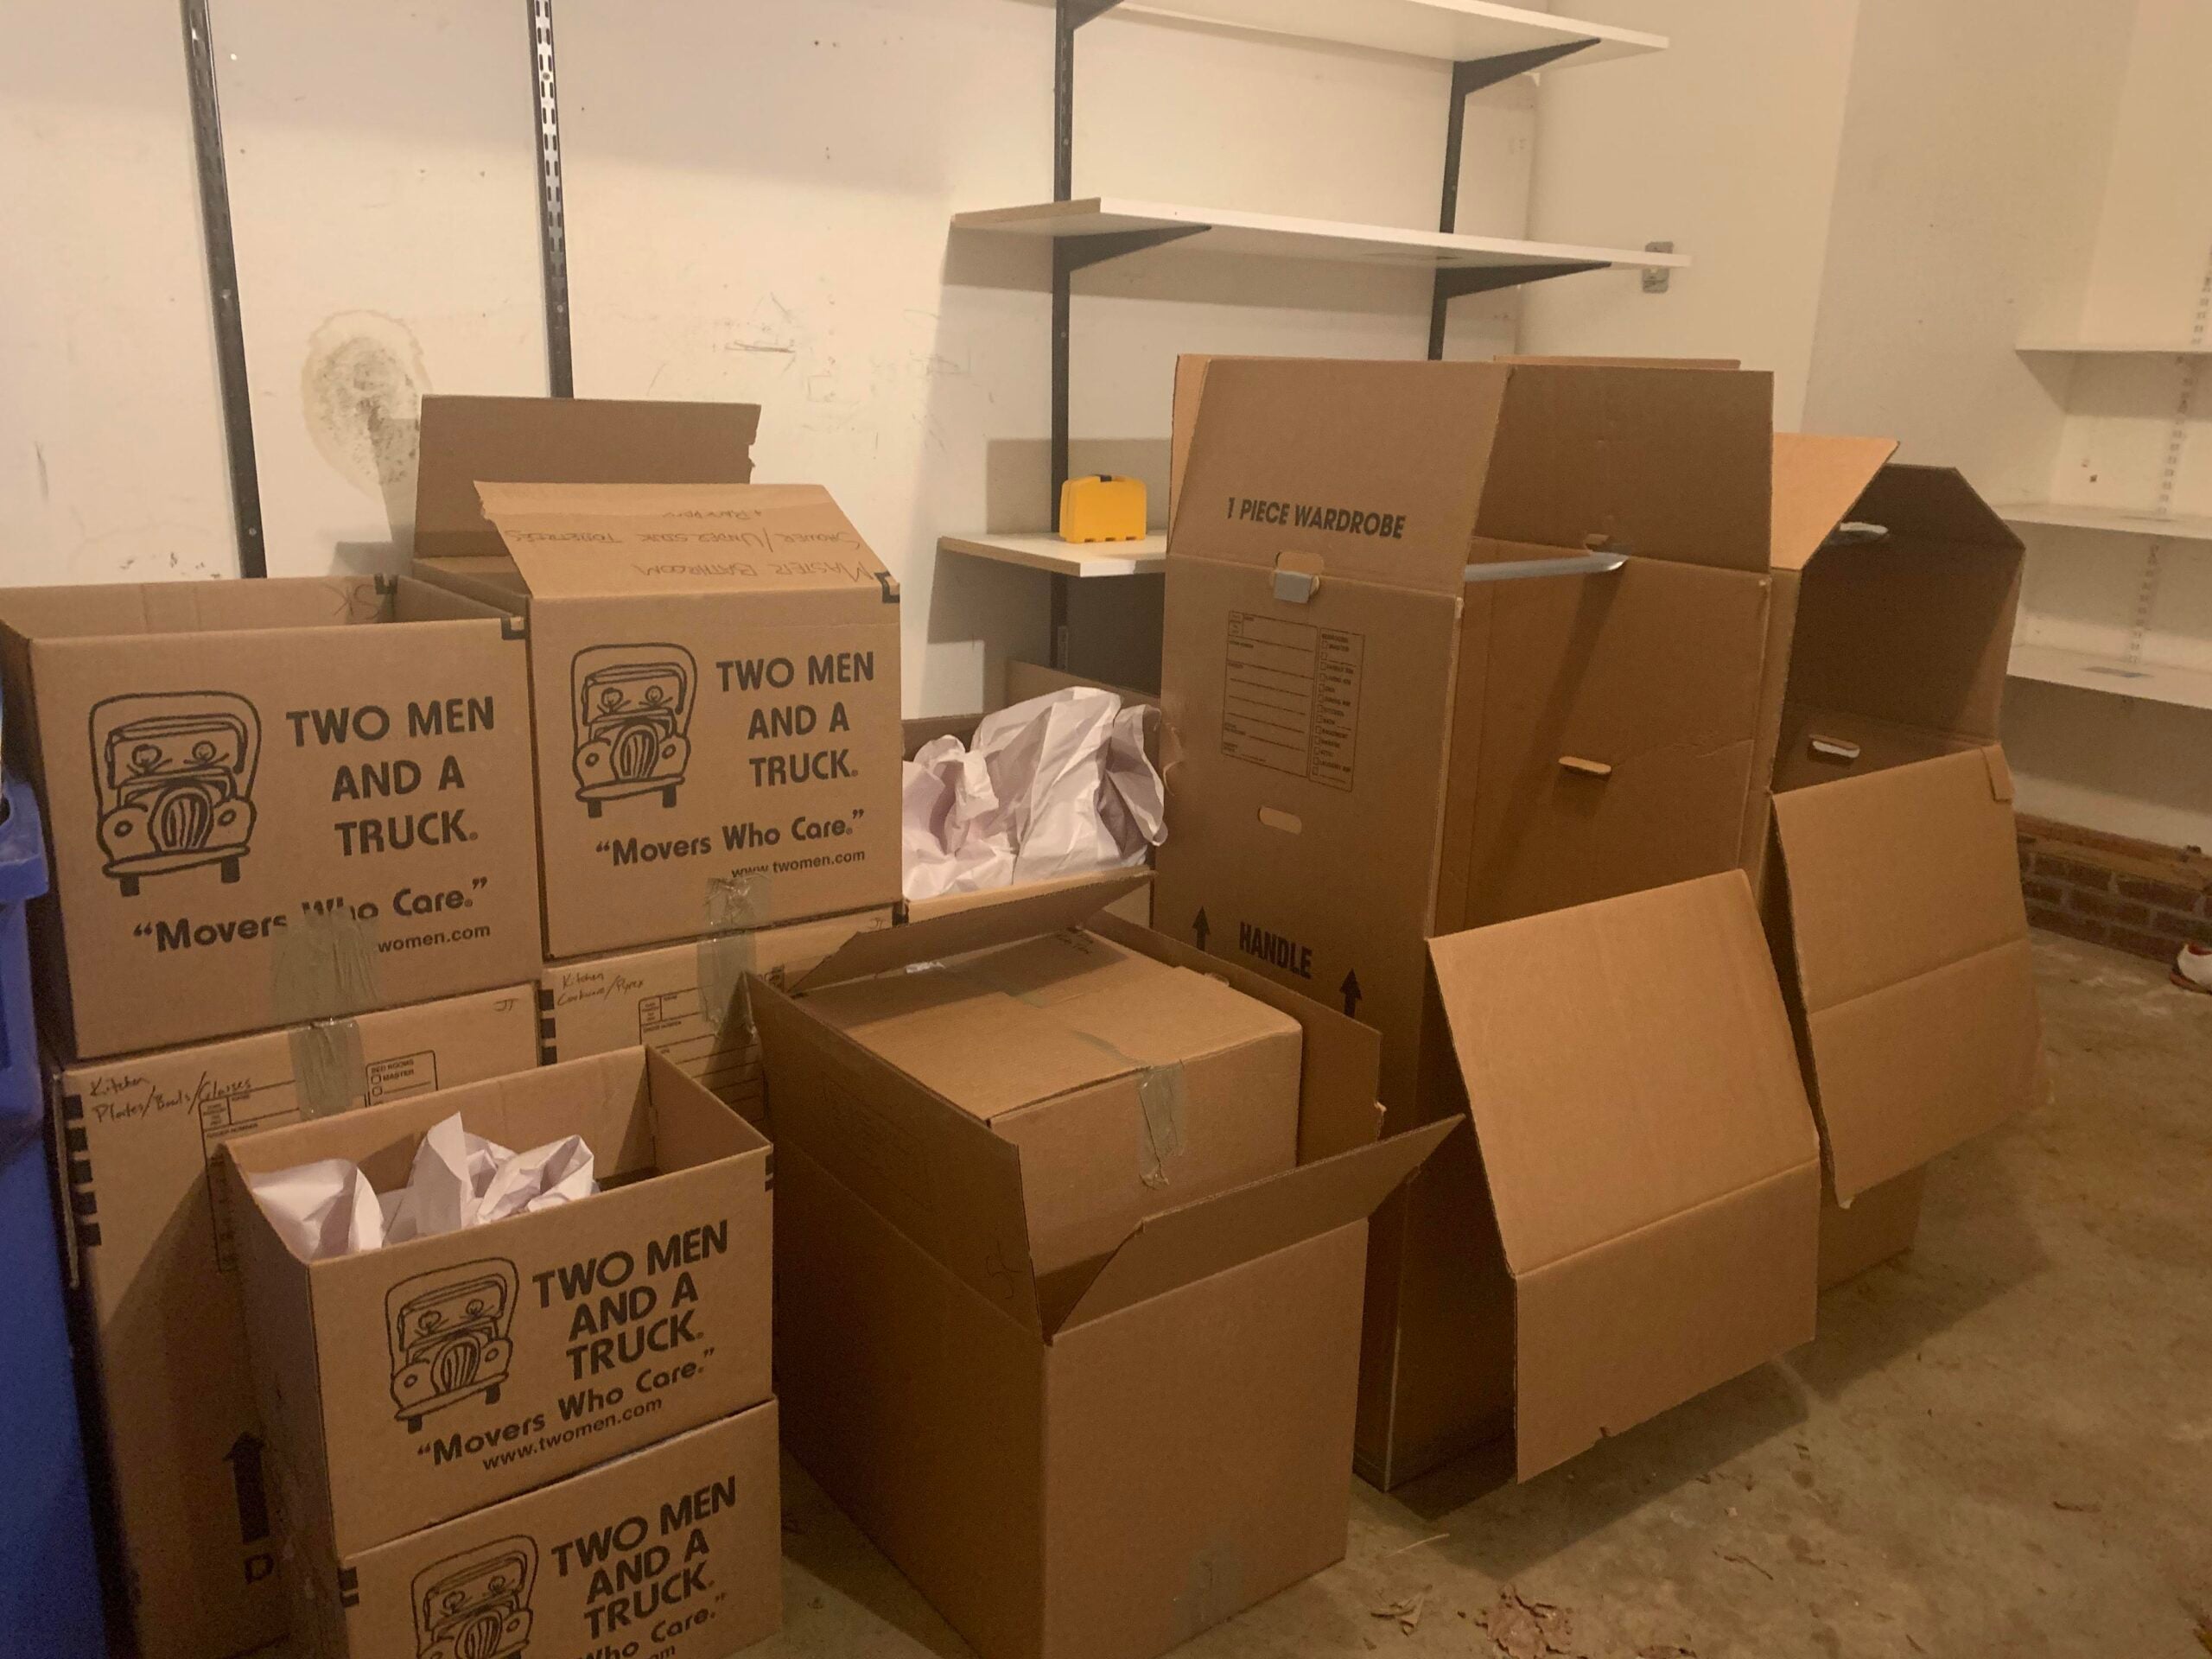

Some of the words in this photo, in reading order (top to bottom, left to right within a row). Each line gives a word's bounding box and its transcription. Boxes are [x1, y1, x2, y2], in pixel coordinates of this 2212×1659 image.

[1227, 497, 1236, 519] 1
[1239, 499, 1290, 525] PIECE
[1294, 504, 1407, 539] WARDROBE
[633, 563, 757, 579] BATHROOM
[767, 562, 876, 583] MASTER
[715, 658, 794, 692] TWO
[808, 651, 874, 686] MEN
[286, 704, 391, 747] TWO
[408, 696, 494, 738] MEN
[747, 704, 817, 741] AND
[829, 702, 849, 732] A
[332, 759, 422, 802] AND
[438, 755, 465, 791] A
[595, 836, 711, 866] “Movers
[721, 822, 780, 851] Who
[1239, 922, 1313, 979] HANDLE
[90, 1076, 151, 1097] Kitchen
[383, 1069, 415, 1082] MASTER
[531, 1250, 634, 1309] TWO
[647, 1219, 728, 1275] MEN
[568, 1286, 658, 1343] AND
[671, 1272, 698, 1307] A
[416, 1413, 546, 1465] “Movers
[557, 1387, 624, 1422] Who
[482, 1397, 662, 1470] www.twomen.com
[550, 1516, 648, 1577] TWO
[659, 1475, 737, 1533] MEN
[586, 1546, 670, 1605] AND
[684, 1528, 710, 1562] A
